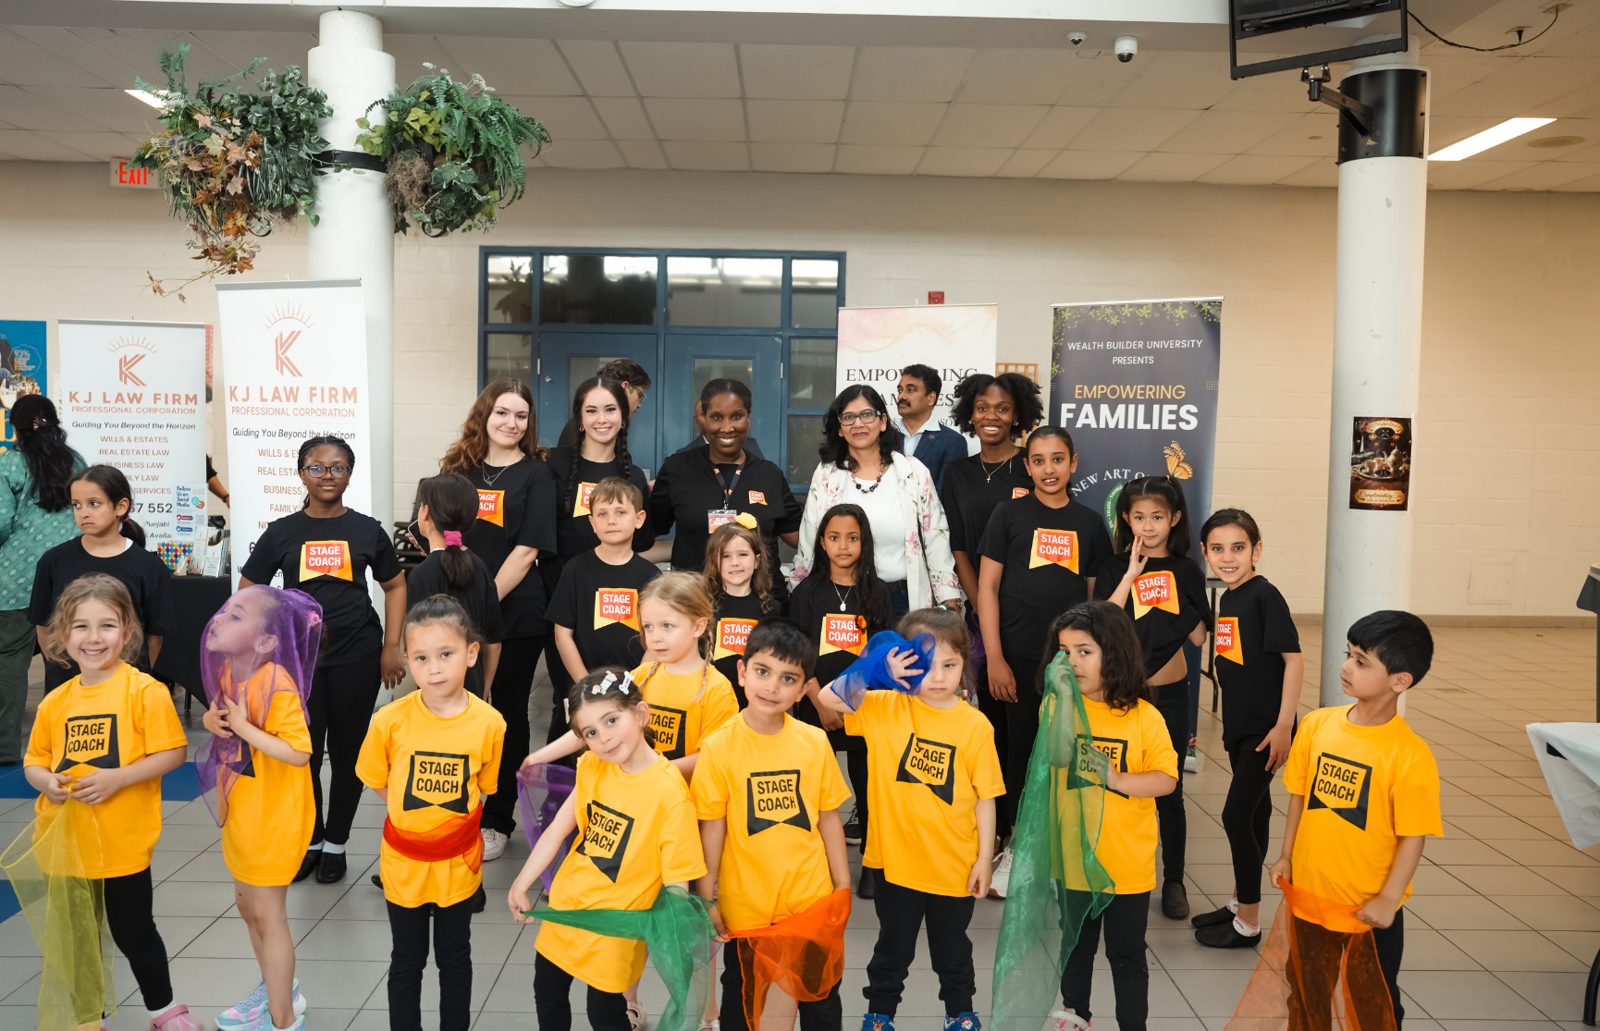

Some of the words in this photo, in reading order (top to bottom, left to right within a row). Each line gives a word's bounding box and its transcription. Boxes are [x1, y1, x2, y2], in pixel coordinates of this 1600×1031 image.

[1067, 341, 1104, 350] WEALTH
[1106, 340, 1144, 350] BUILDER
[1146, 339, 1203, 349] UNIVERSITY
[1112, 356, 1155, 365] PRESENTS
[259, 385, 300, 403] LAW
[309, 386, 358, 404] FIRM
[1074, 384, 1186, 400] EMPOWERING
[102, 392, 143, 405] LAW
[153, 393, 198, 406] FIRM
[71, 406, 133, 414] PROFESSIONAL
[136, 406, 196, 415] CORPORATION
[231, 406, 291, 416] PROFESSIONAL
[292, 407, 355, 418] CORPORATION
[1059, 402, 1199, 431] FAMILIES
[71, 420, 102, 430] Guiding
[104, 421, 119, 429] You
[120, 421, 151, 431] Beyond
[152, 422, 164, 430] the
[165, 422, 196, 431] Horizon
[232, 427, 259, 438] Guiding
[261, 428, 277, 438] You
[278, 429, 307, 440] Beyond
[133, 436, 169, 444] ESTATES
[152, 449, 170, 457] LAW
[257, 449, 281, 458] WILLS
[283, 450, 290, 458] &
[146, 461, 165, 469] LAW
[257, 466, 277, 476] REAL
[278, 467, 299, 477] ESTA
[1070, 472, 1099, 496] NEW
[1103, 468, 1131, 481] ART
[133, 487, 172, 495] SERVICES
[264, 485, 303, 495] BUSINESS
[479, 493, 497, 501] AGE
[147, 503, 173, 514] 552
[269, 503, 298, 513] FAMILY
[479, 502, 495, 511] ACH
[1041, 533, 1070, 545] STAGE
[309, 546, 341, 556] STAGE
[1039, 544, 1071, 556] COACH
[308, 556, 341, 567] COACH
[1138, 576, 1167, 590] STAGE
[602, 593, 631, 604] STAGE
[1139, 588, 1168, 602] COACH
[602, 605, 631, 615] COACH
[723, 635, 748, 646] COAC
[828, 631, 859, 643] COACH
[650, 713, 676, 730] TAGE
[70, 722, 105, 738] STAGE
[653, 730, 674, 745] ACH
[67, 738, 105, 753] COACH
[1080, 743, 1118, 760] SGE
[419, 760, 460, 777] STAGE
[910, 755, 945, 780] COACH
[1321, 762, 1359, 785] STAGE
[416, 777, 459, 794] COACH
[757, 778, 794, 795] STAGE
[1317, 778, 1356, 802] COACH
[757, 795, 797, 812] COACH
